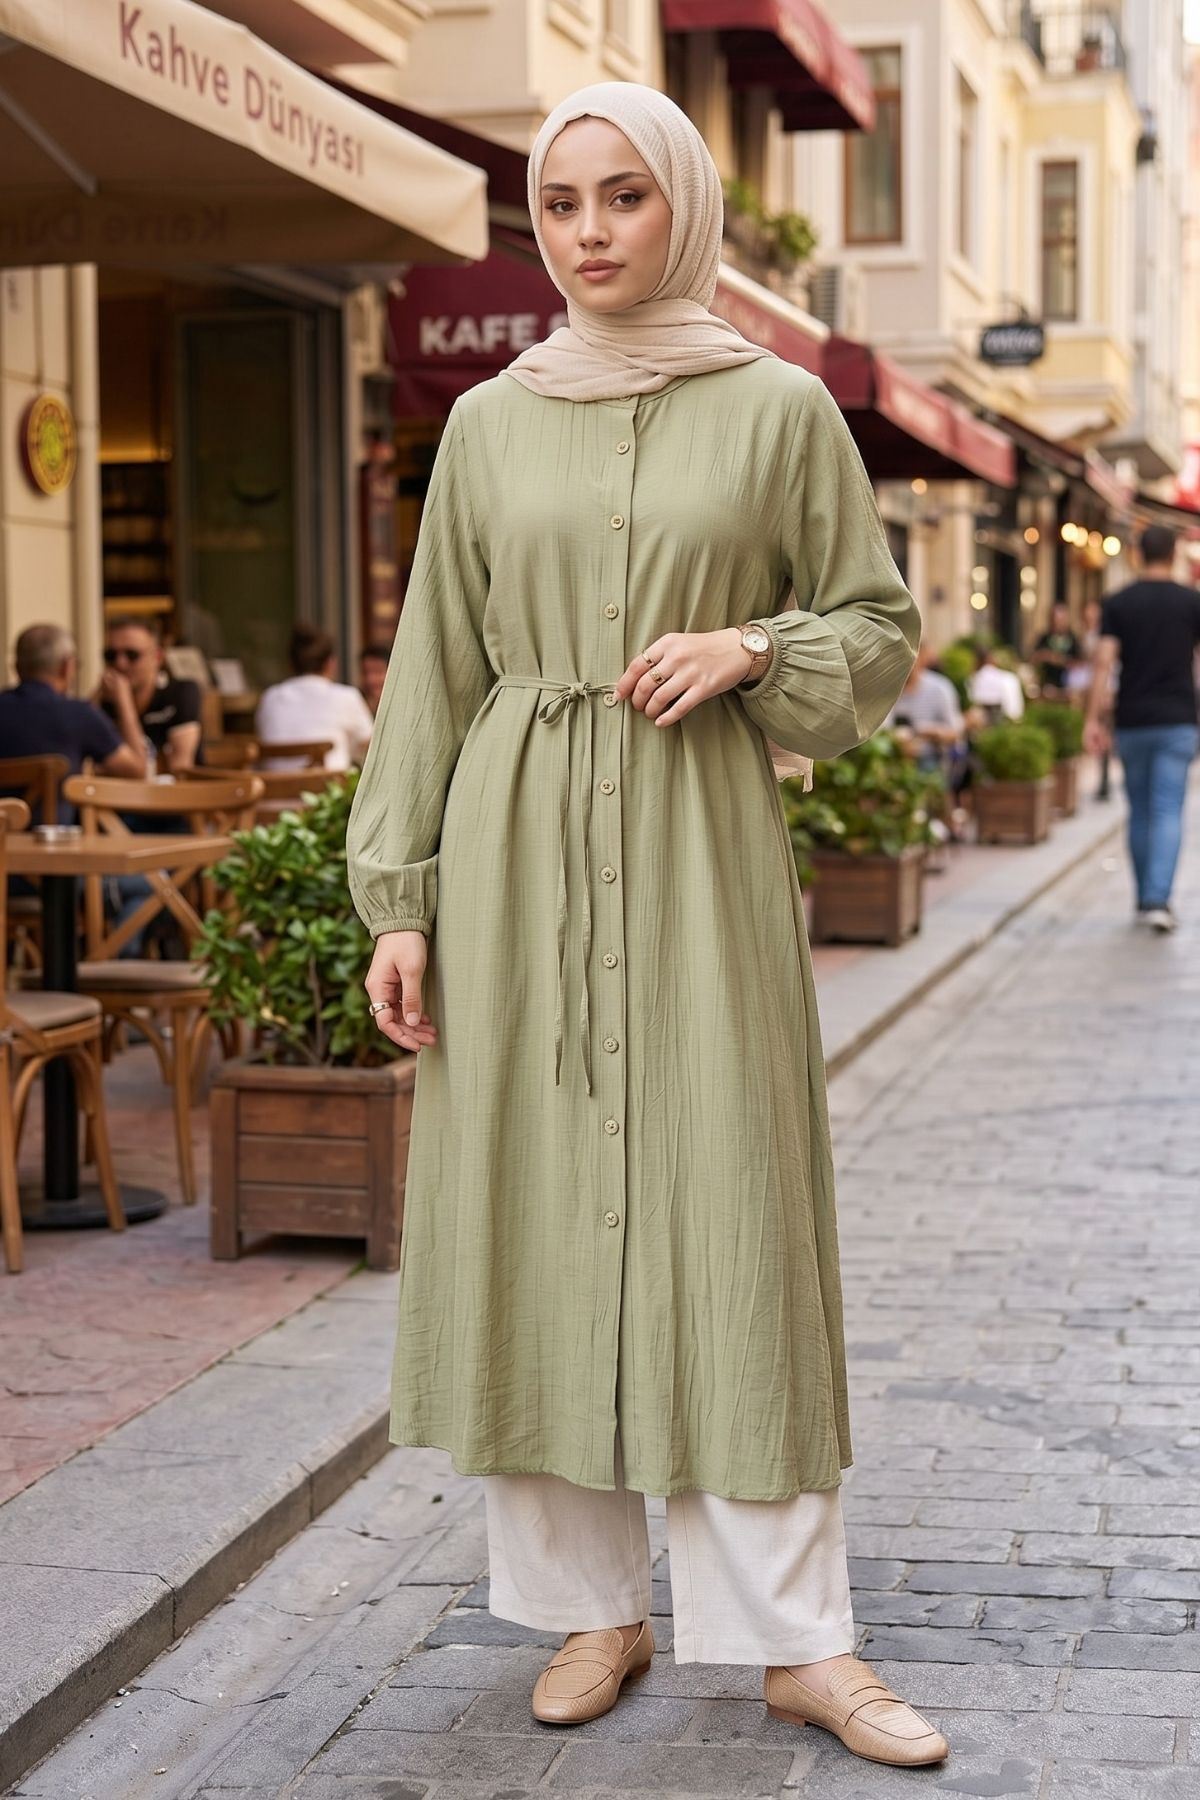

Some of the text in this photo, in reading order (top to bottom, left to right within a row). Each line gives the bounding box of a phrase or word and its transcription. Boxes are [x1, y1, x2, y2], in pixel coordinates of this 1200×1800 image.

[119, 1, 366, 176] Kahve Dünyası
[419, 313, 539, 355] KAFE
